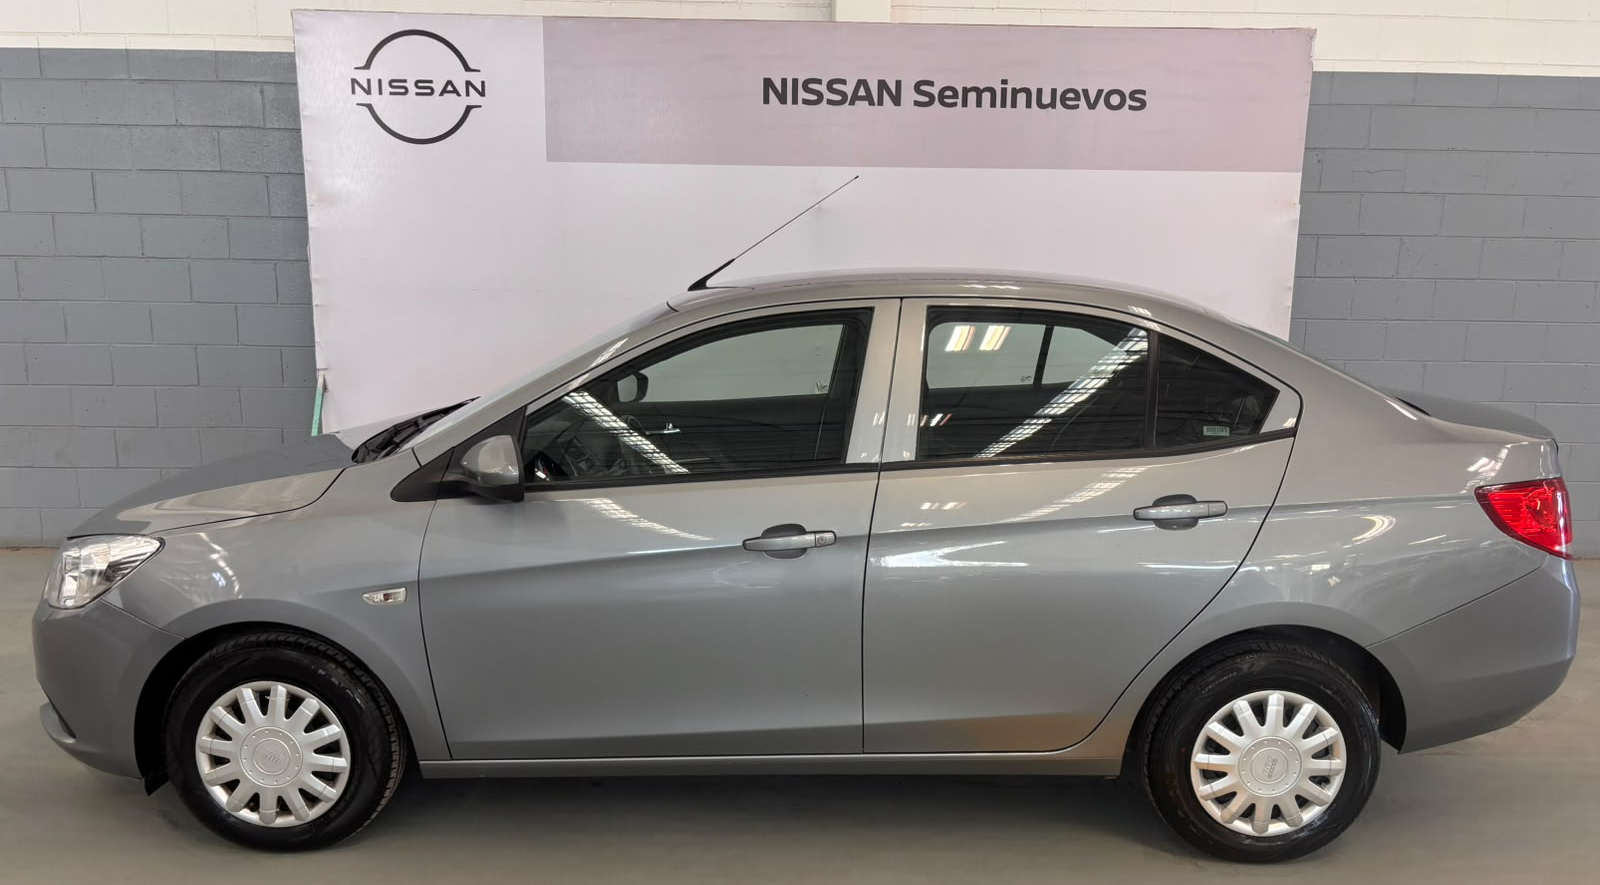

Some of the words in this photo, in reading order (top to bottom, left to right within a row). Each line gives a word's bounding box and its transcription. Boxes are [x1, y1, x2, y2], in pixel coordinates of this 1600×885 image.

[350, 78, 486, 97] NISSAN
[762, 77, 902, 107] NISSAN
[913, 79, 1147, 112] Seminuevos
